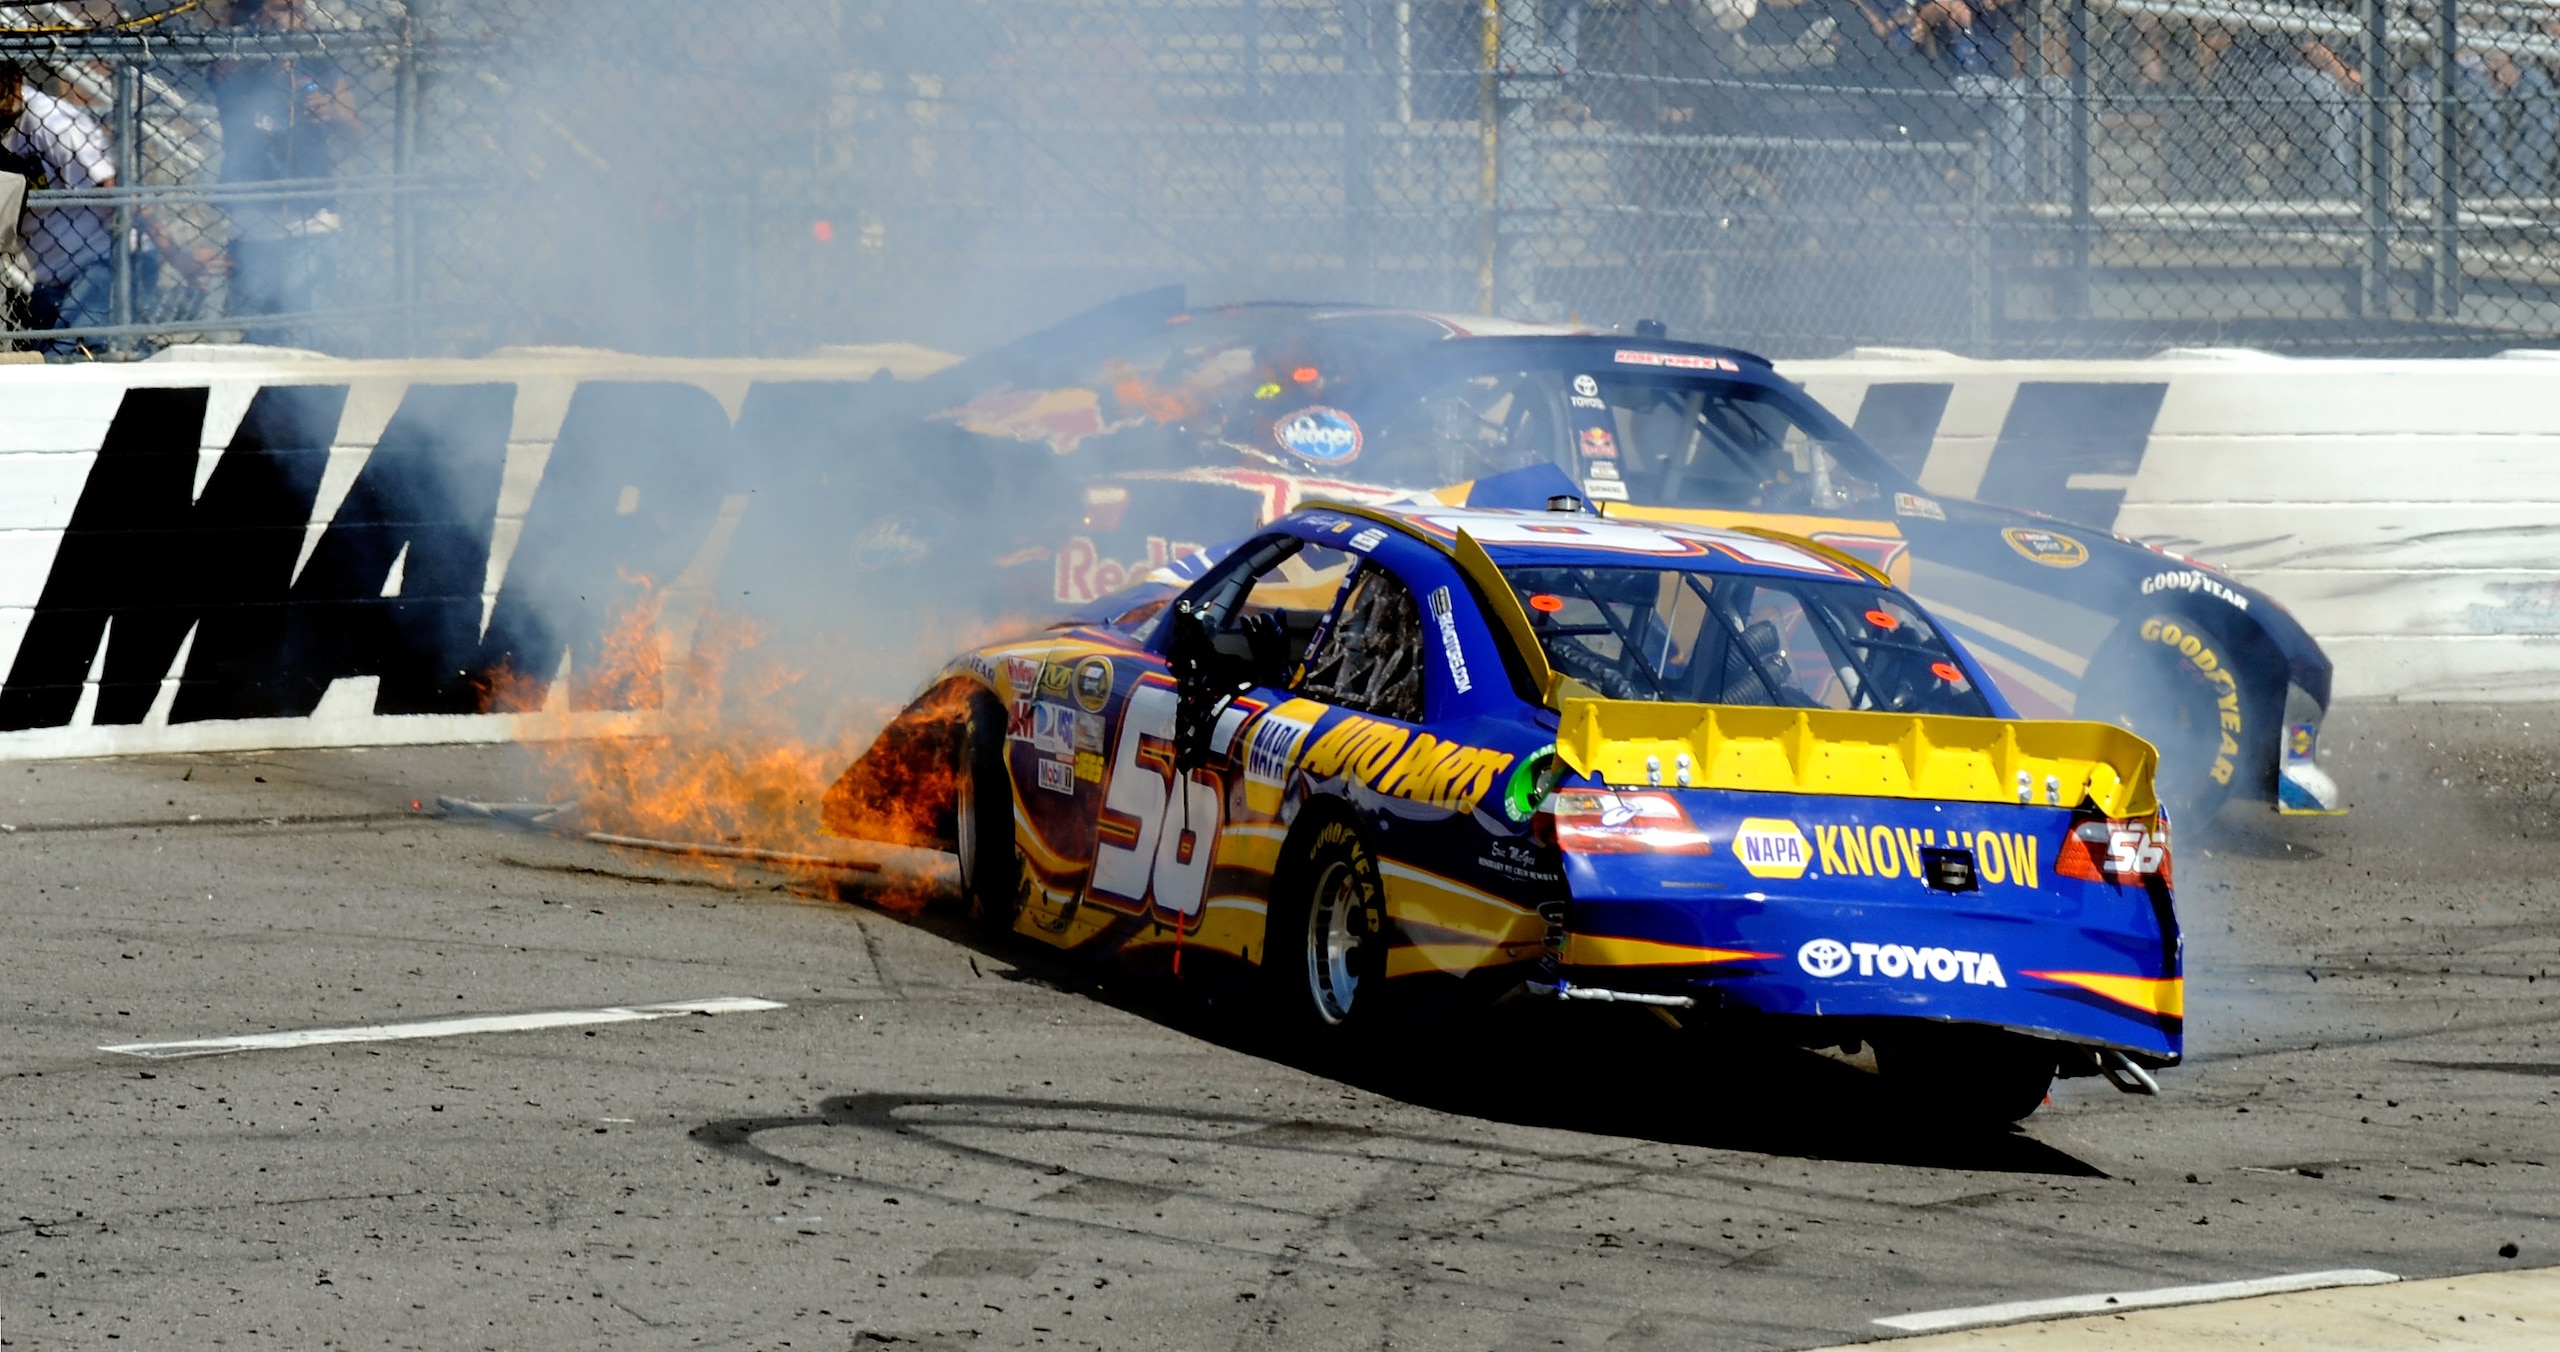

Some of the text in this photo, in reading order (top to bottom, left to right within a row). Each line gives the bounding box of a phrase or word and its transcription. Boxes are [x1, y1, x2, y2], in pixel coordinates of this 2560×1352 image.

[1285, 415, 1353, 457] Kroger
[2141, 569, 2249, 611] GOODYEAR
[2140, 619, 2242, 786] GOODYEAR
[1247, 718, 1302, 780] NAPA
[1301, 715, 1515, 815] AUTO PARTS
[1088, 676, 1262, 925] 56
[1745, 836, 1801, 862] NAPA
[2103, 830, 2166, 874] 56
[1529, 870, 1559, 881] MEMBER
[1851, 942, 2007, 988] TOYOTA
